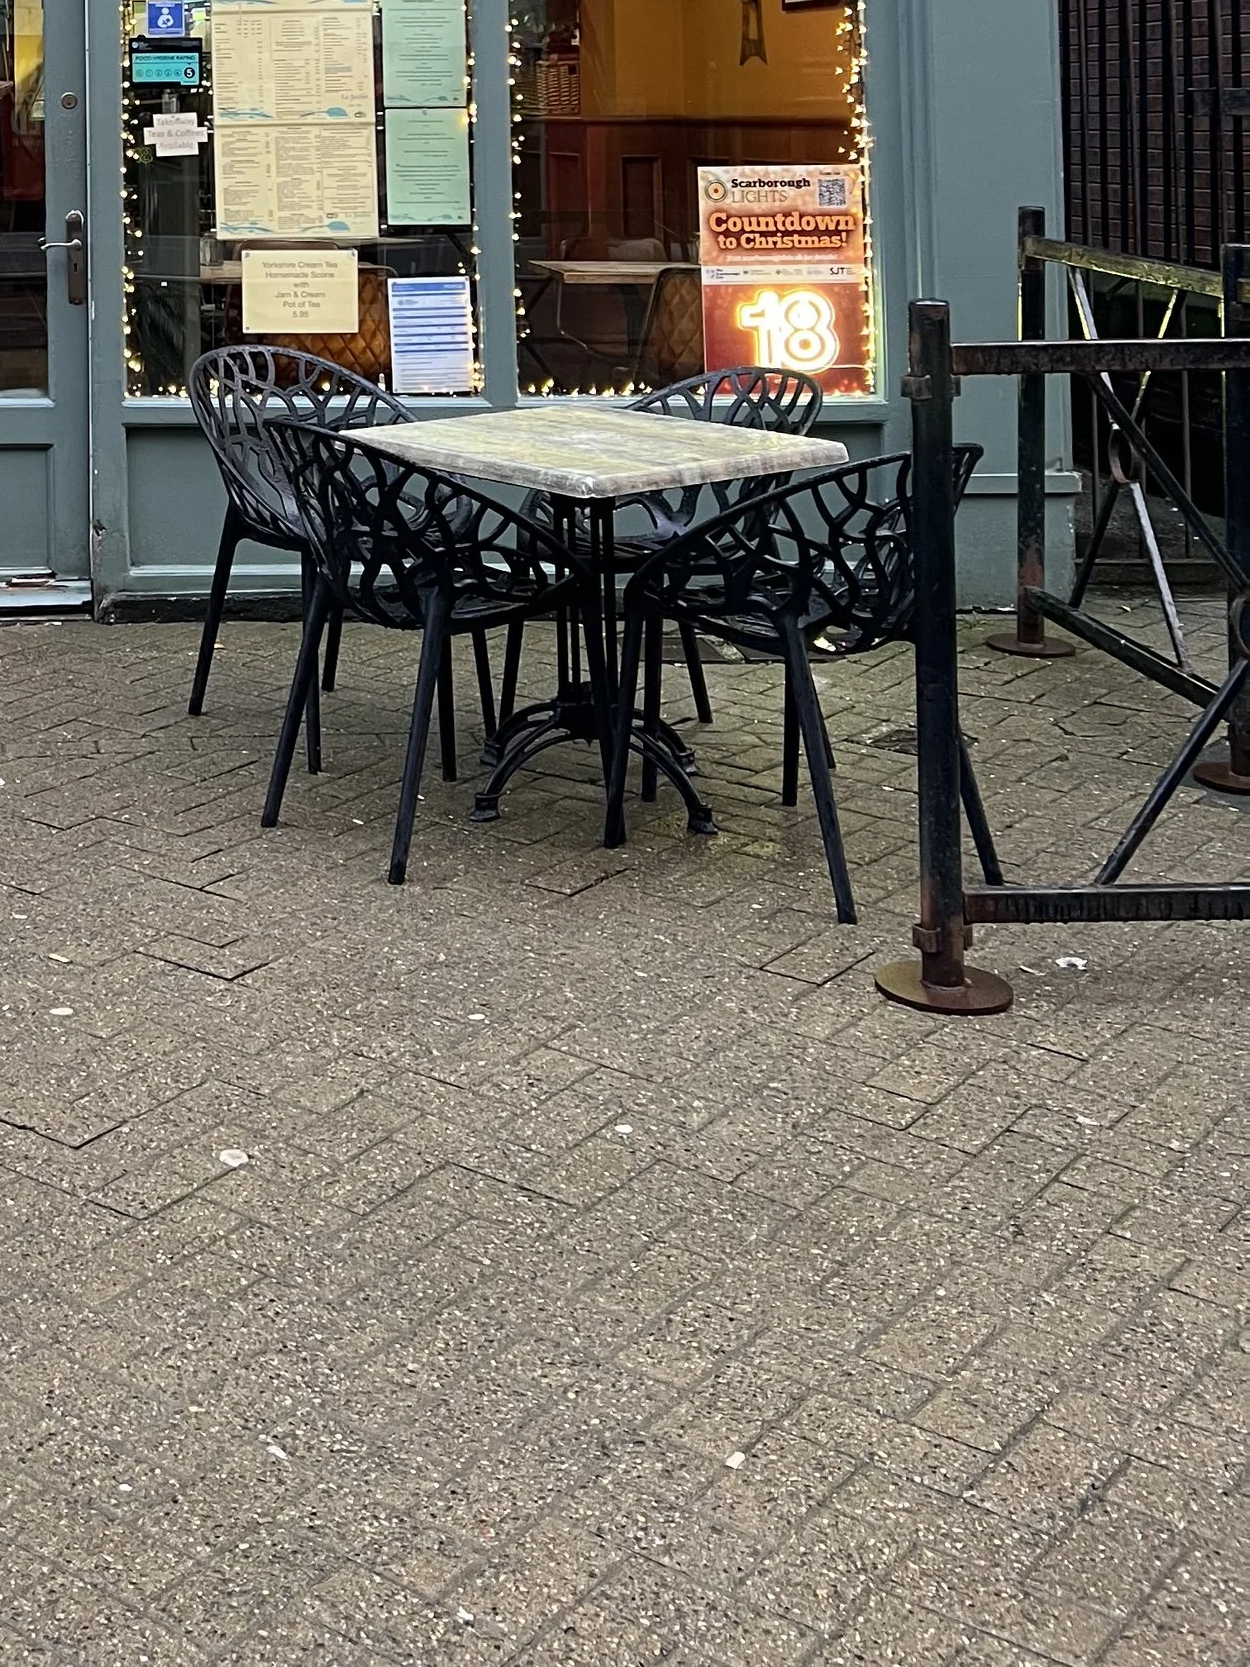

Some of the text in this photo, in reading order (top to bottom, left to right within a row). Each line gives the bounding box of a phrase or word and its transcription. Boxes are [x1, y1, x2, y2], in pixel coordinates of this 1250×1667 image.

[186, 68, 193, 78] 5
[148, 130, 165, 138] Teas
[174, 129, 204, 137] Coffees
[159, 142, 194, 150] Available
[731, 178, 811, 190] Scarborough
[732, 190, 788, 203] LIGHTS
[709, 210, 856, 233] Countdown
[717, 232, 847, 250] to Christmas!
[262, 261, 296, 269] Yorkshire
[265, 271, 309, 279] Homemade
[829, 267, 845, 276] SJT
[275, 291, 291, 299] Jam
[739, 289, 839, 375] 18
